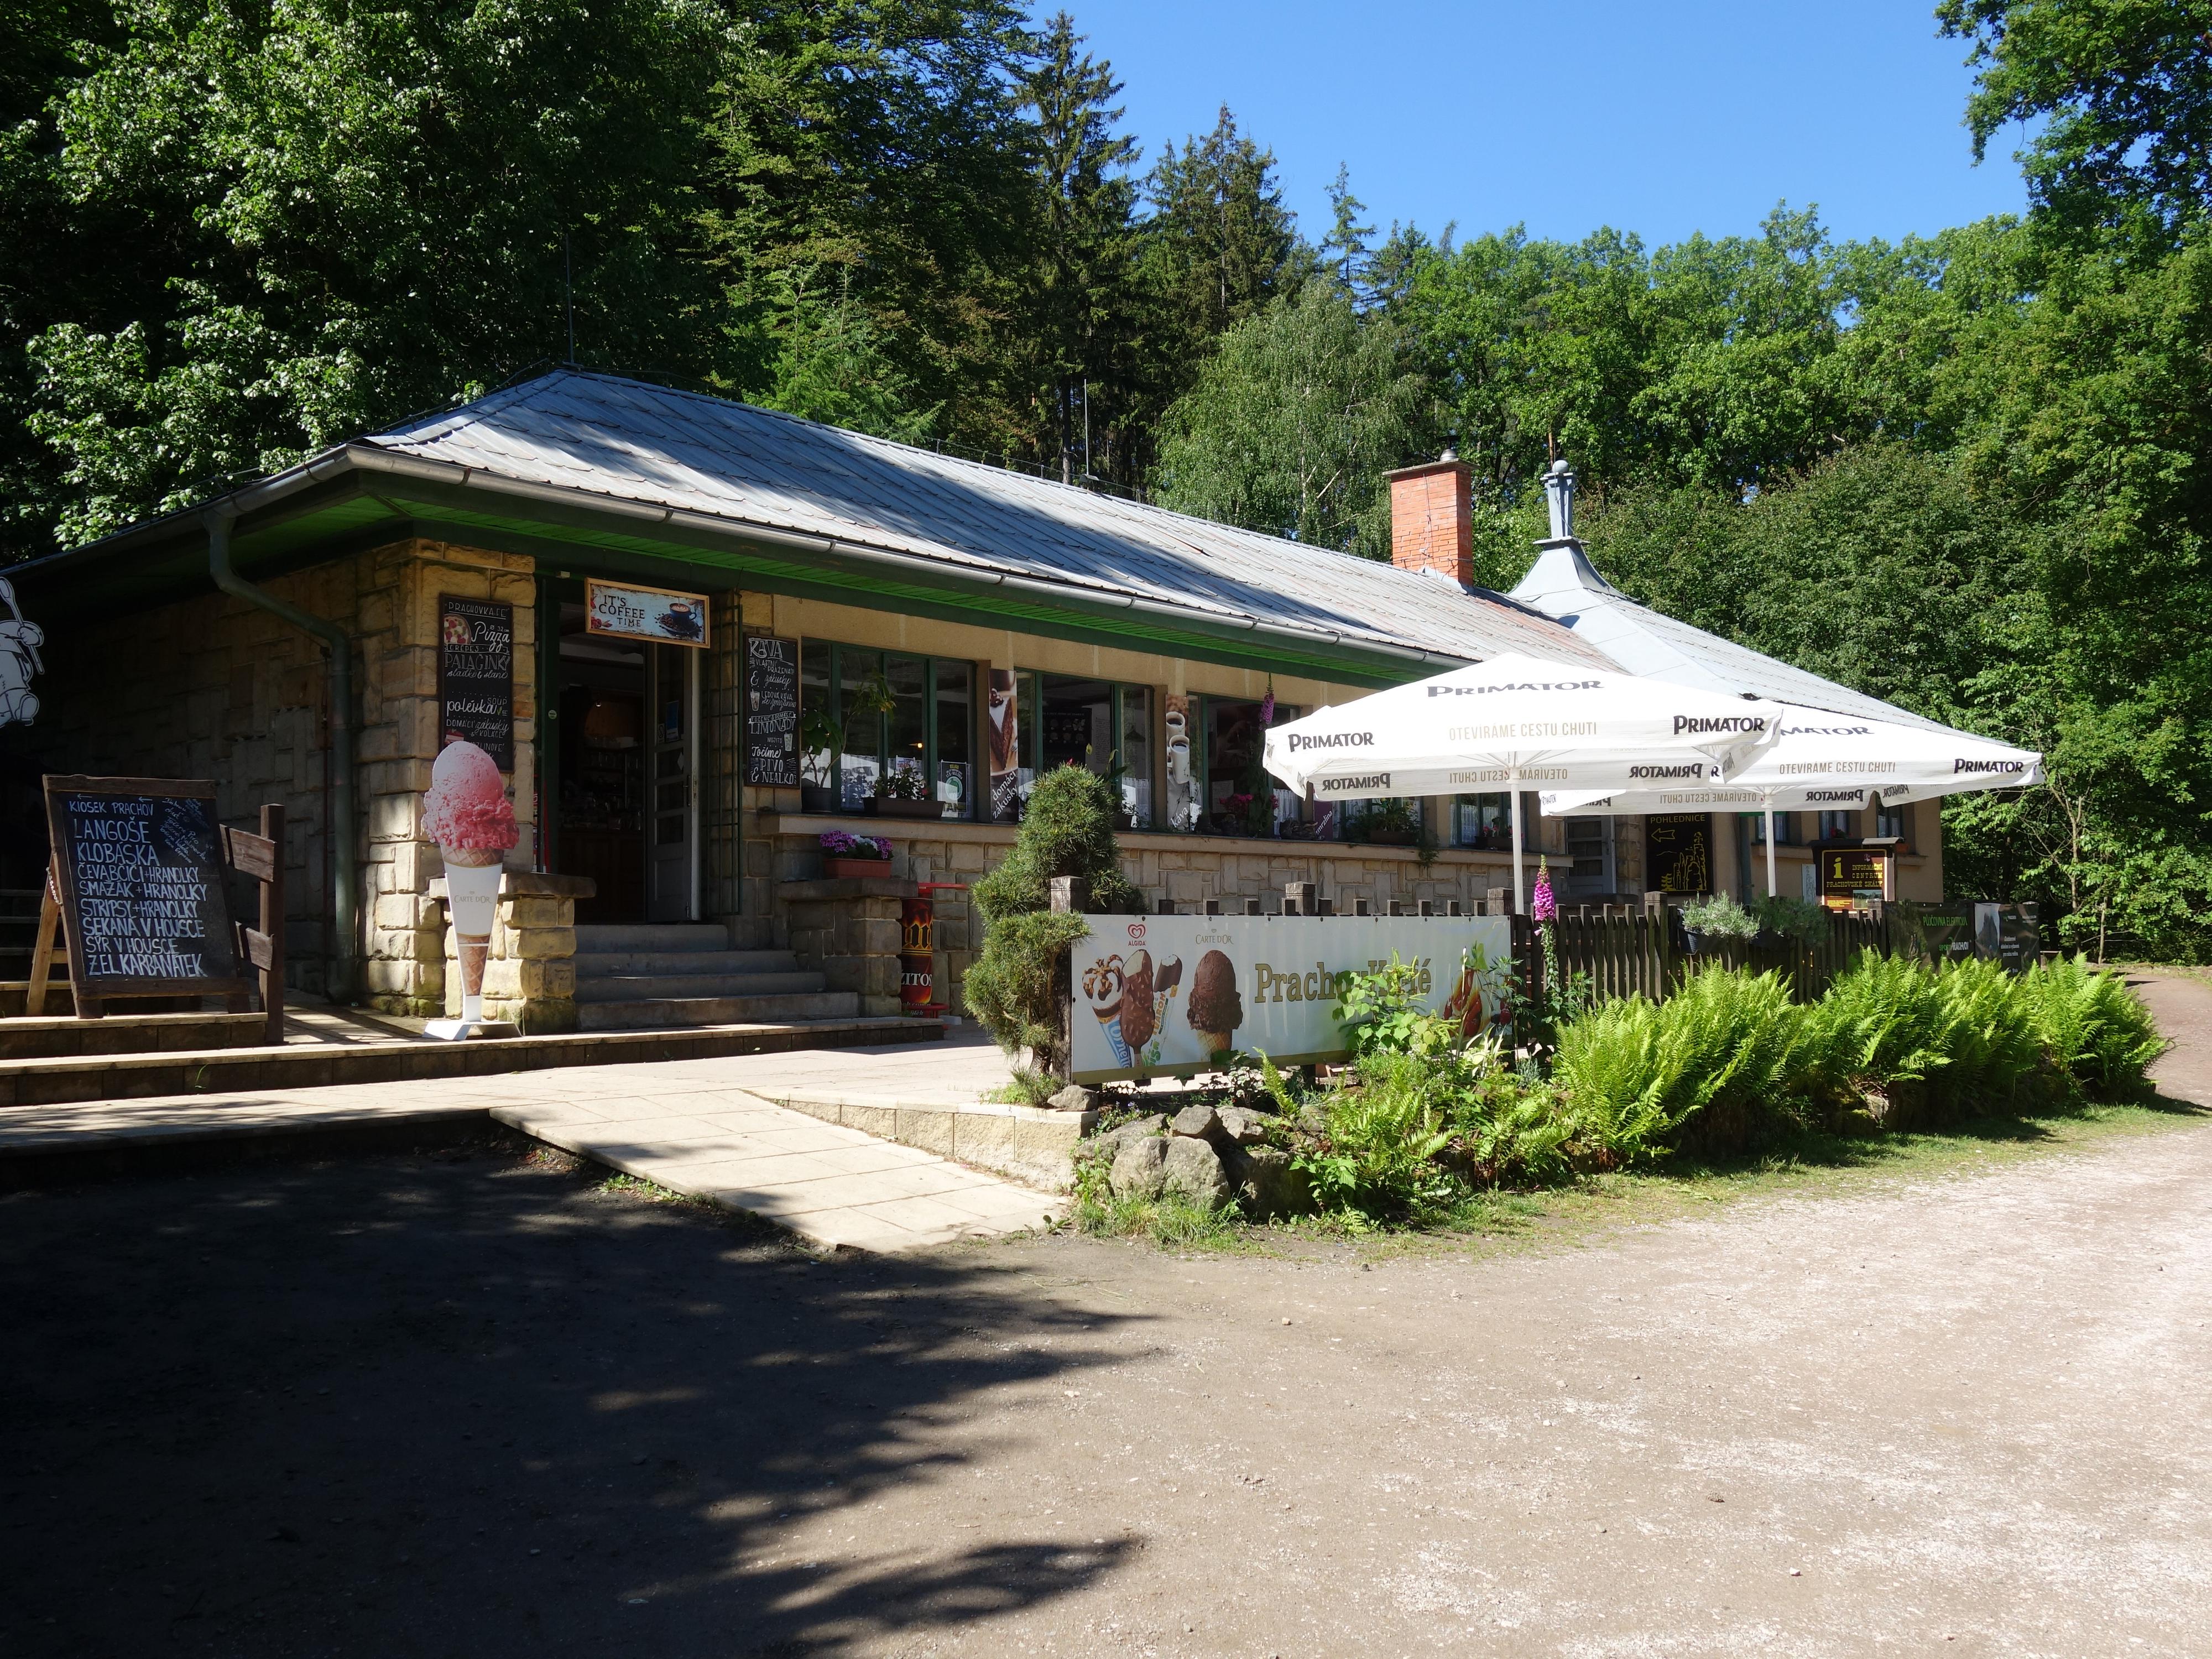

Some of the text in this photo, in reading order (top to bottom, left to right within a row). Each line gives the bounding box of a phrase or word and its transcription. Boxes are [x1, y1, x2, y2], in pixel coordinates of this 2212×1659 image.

[603, 594, 626, 607] IT'S
[599, 604, 645, 619] COFFEE
[617, 617, 641, 627] TIME
[471, 621, 510, 653] Pizza
[447, 698, 497, 717] polévka
[487, 697, 507, 706] SOUP
[1449, 722, 1597, 741] OTEVÍRÁME CESTU CHUTI
[759, 758, 784, 772] PIVO
[1780, 761, 1896, 774] OTEVÍRÁME CESTU CHUTI
[751, 766, 794, 785] & NEALKO
[69, 801, 154, 816] KIOSEK PRACHOV
[993, 785, 1018, 819] zákusky
[1170, 807, 1188, 828] káva
[1650, 814, 1705, 824] POHLEDNICE
[74, 816, 151, 843] LANGOŠE
[77, 841, 160, 867] KLOBÁSKA
[79, 880, 134, 898] SMAŽÁK
[143, 884, 207, 901] HRANOLKY
[455, 895, 474, 903] CARTE
[83, 916, 205, 938] SEKANÁ V HOUSCE
[86, 935, 178, 955] SÝR V HOUSCE
[1196, 934, 1215, 945] CARTE
[119, 952, 208, 978] KARBANÁTEK
